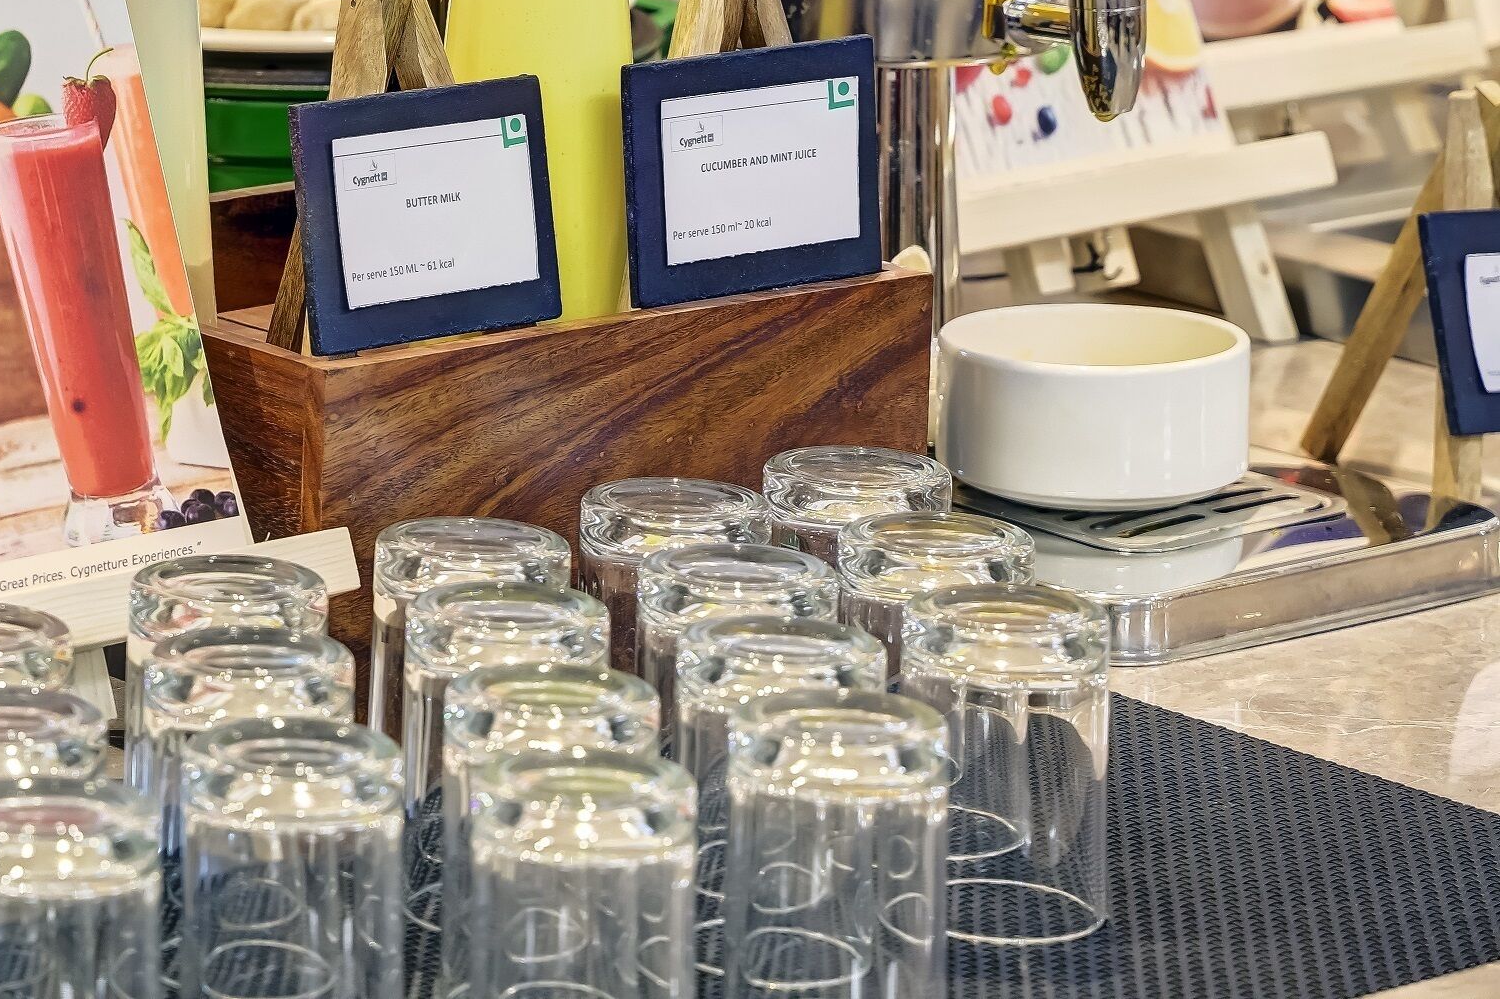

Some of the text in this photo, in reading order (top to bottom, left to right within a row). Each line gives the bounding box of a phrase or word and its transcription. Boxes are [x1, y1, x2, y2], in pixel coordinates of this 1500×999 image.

[679, 134, 708, 148] Cygnett
[700, 148, 817, 173] CUCUMBER AND MINT JUICE
[352, 173, 381, 187] Cygnett
[405, 191, 461, 209] BUTTER MILK
[672, 230, 686, 241] Per
[688, 227, 709, 239] serve
[711, 223, 726, 235] 150
[744, 219, 755, 230] 20
[756, 216, 772, 228] kcal
[351, 272, 365, 282] Per
[366, 269, 388, 280] serve
[389, 265, 404, 277] 150
[405, 263, 419, 274] ML
[427, 259, 438, 271] 61
[439, 257, 455, 269] kcal
[32, 569, 67, 585] Prices.
[70, 556, 129, 579] Cygnetture
